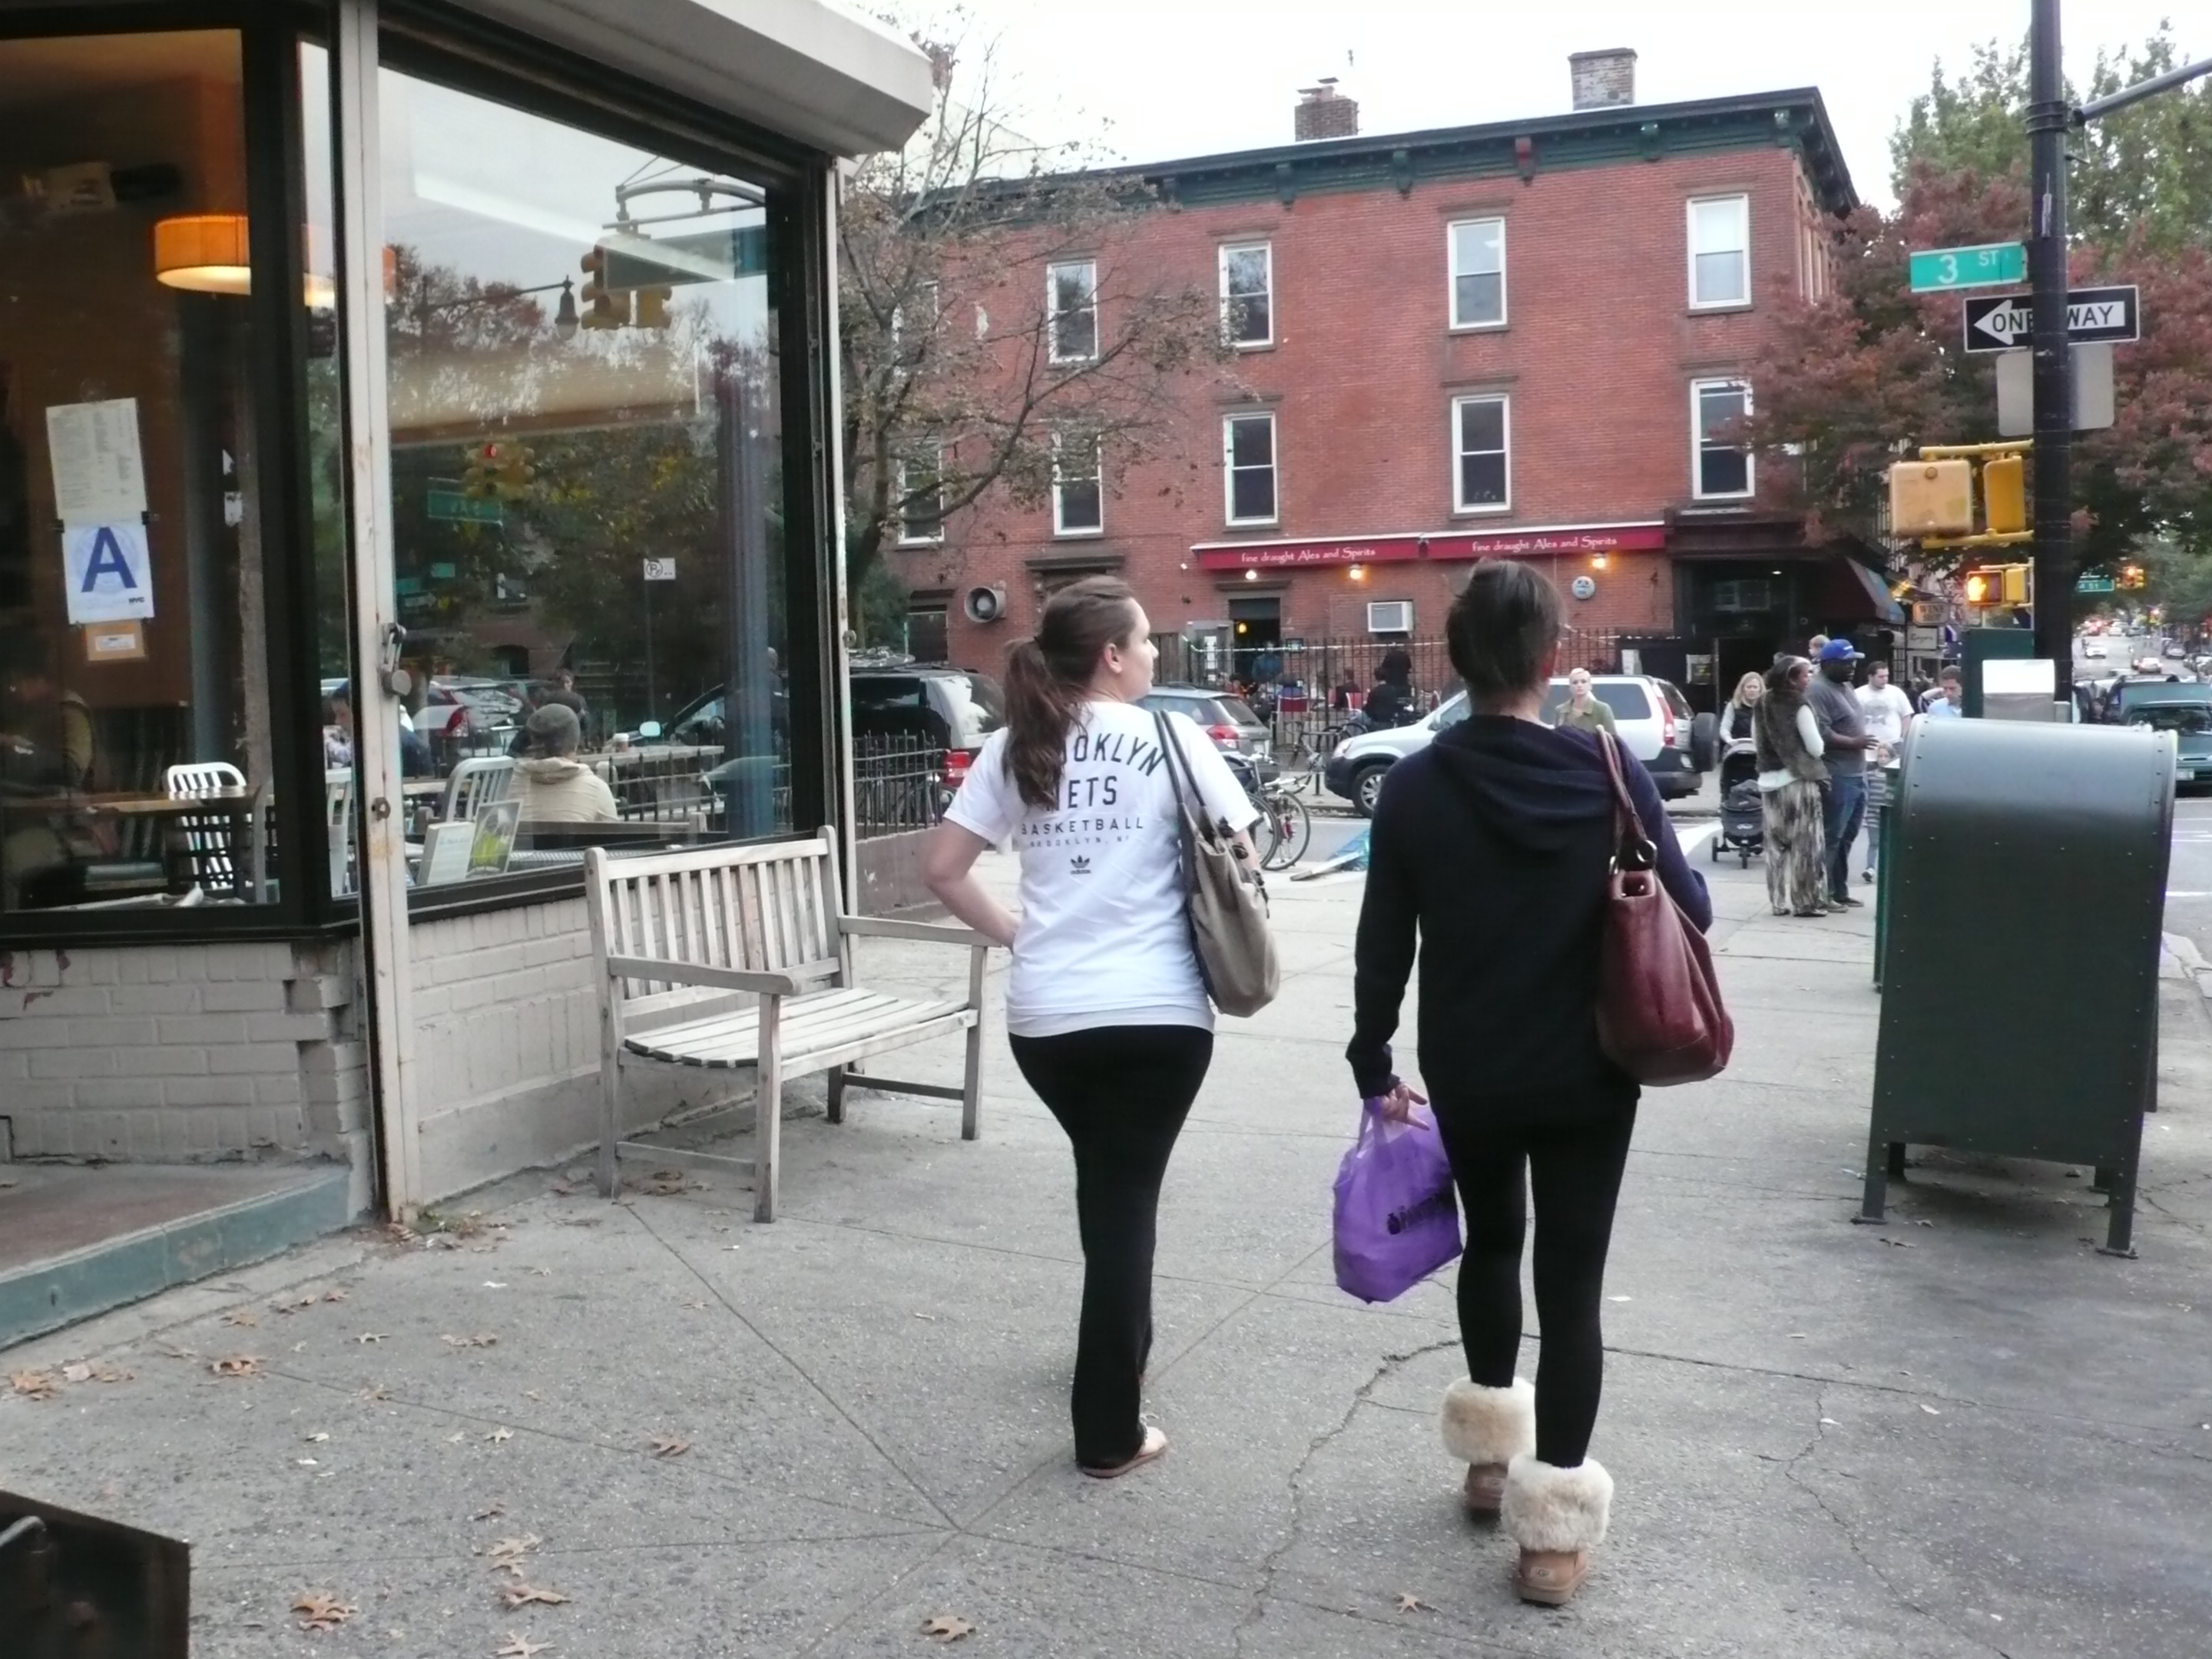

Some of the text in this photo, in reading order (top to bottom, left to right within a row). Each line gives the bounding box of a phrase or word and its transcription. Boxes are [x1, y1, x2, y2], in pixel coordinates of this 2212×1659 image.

[1938, 250, 1999, 283] 3 ST
[1472, 535, 1618, 553] fine draught Ales and Spirits
[81, 527, 137, 592] A
[1241, 547, 1376, 565] fine draught Ales and Spirits
[1022, 817, 1143, 835] BASKETBALL
